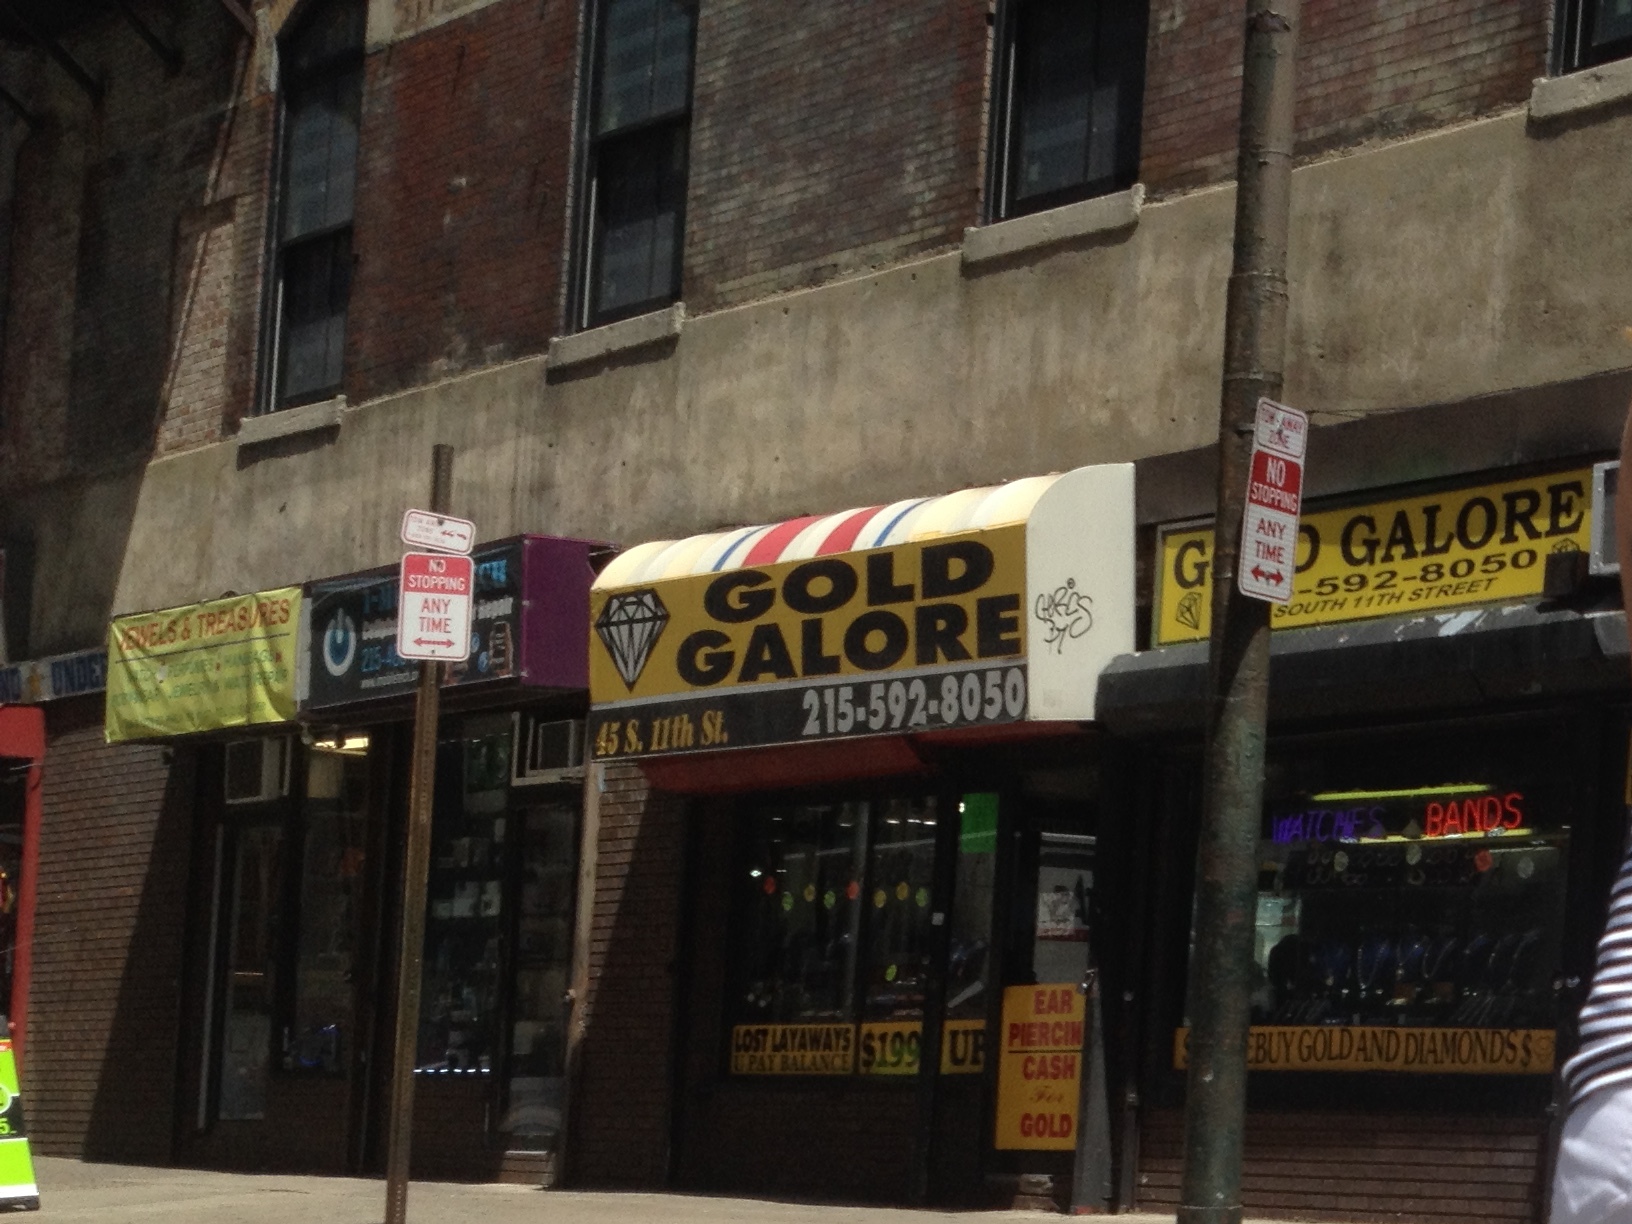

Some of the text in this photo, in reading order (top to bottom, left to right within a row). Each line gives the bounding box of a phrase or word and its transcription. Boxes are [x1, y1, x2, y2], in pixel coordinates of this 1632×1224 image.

[1266, 457, 1286, 487] NO
[1250, 482, 1297, 512] STOPPING
[1256, 517, 1287, 541] ANY
[1341, 480, 1586, 567] GALORE
[1255, 540, 1285, 565] TIME
[428, 558, 447, 574] NO
[408, 574, 466, 591] STOPPING
[703, 540, 995, 624] GOLD
[420, 597, 451, 615] ANY
[1274, 578, 1499, 619] SOUTH 11TH STREET
[197, 599, 290, 638] TREASURES
[419, 616, 452, 634] TIME
[676, 593, 1022, 687] GALORE
[801, 667, 1026, 737] 215-592-8050
[651, 713, 694, 751] 11th
[1425, 792, 1524, 837] BANDS
[1034, 989, 1074, 1015] EAR
[734, 1027, 851, 1052] LOST LAYAWAYS
[1008, 1021, 1083, 1047] PIERCIN
[1300, 1027, 1353, 1062] GOLD
[1356, 1029, 1399, 1062] AND
[1403, 1030, 1518, 1065] DIAMONDS
[780, 1053, 849, 1072] BALANCE
[1022, 1055, 1076, 1080] CASH
[1020, 1112, 1073, 1138] GOLD
